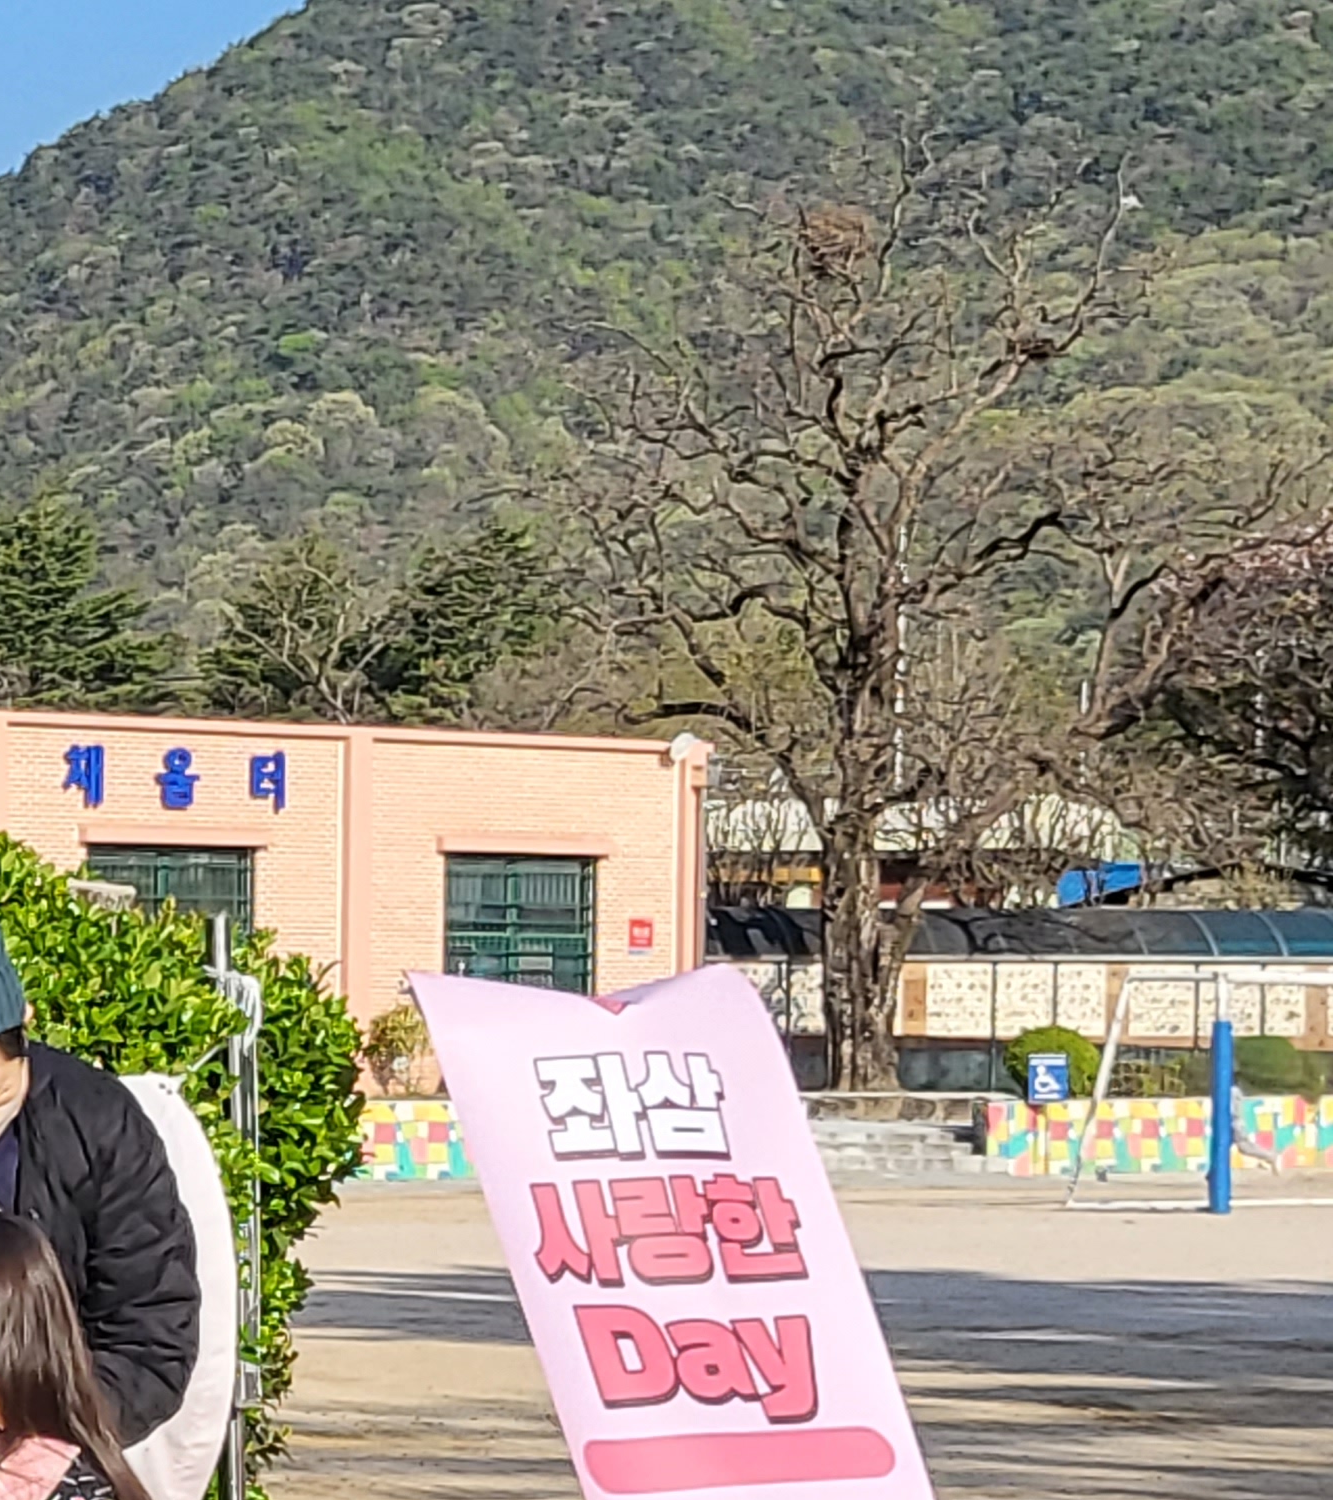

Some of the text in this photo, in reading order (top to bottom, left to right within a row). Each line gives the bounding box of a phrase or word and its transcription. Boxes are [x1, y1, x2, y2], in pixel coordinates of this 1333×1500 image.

[534, 1051, 732, 1160] 좌삼
[531, 1174, 808, 1287] 사랑한
[574, 1304, 818, 1423] Day
